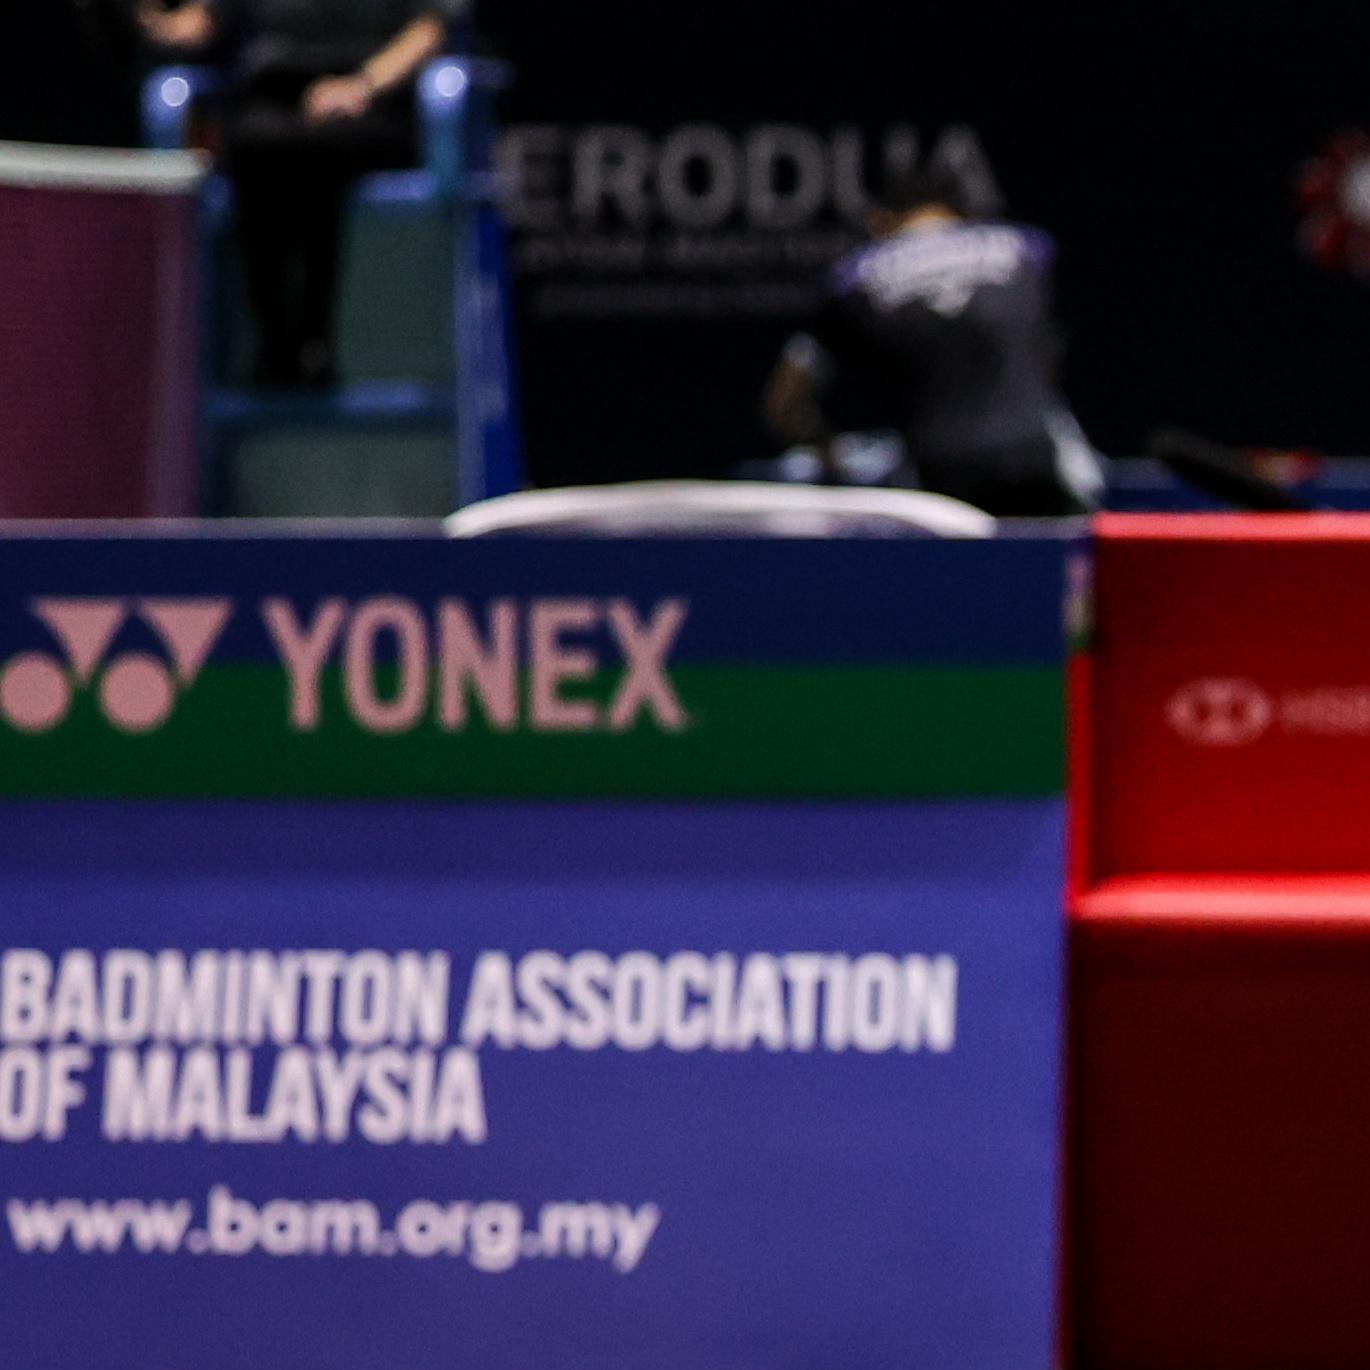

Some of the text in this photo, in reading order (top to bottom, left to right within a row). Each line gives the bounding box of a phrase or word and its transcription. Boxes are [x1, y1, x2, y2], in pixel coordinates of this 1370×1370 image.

[496, 118, 1008, 234] ERODUA
[260, 596, 690, 732] YONEX
[3, 948, 958, 1052] BADMINTON ASSOCIATION
[0, 1044, 487, 1144] OF MALAYSIA
[5, 1184, 660, 1272] www.bam.org.my
